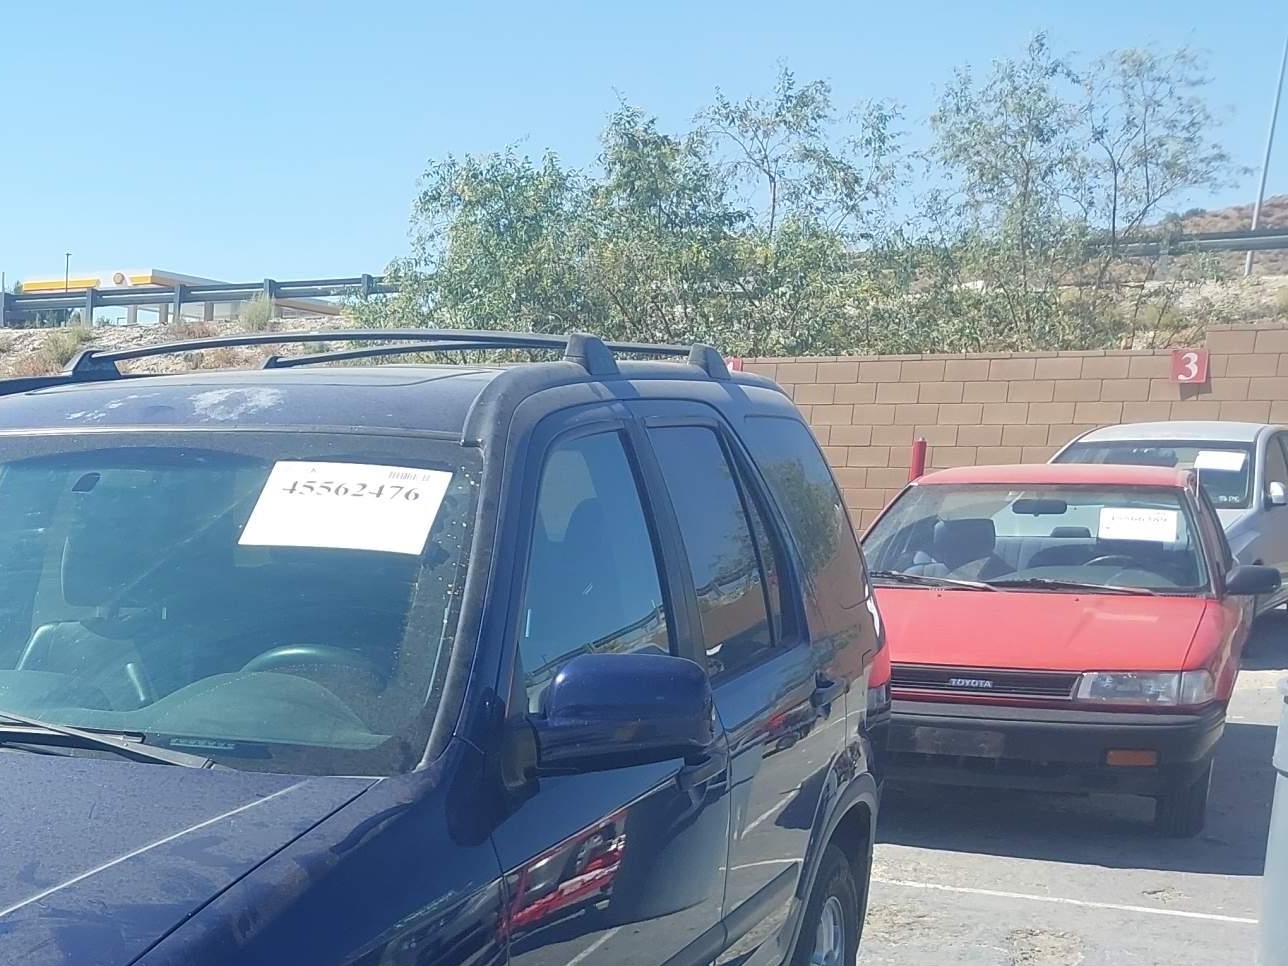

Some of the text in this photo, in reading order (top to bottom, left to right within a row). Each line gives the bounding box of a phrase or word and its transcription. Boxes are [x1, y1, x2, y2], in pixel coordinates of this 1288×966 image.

[1177, 352, 1199, 381] 3
[282, 480, 420, 501] 45562476
[951, 678, 993, 688] TOYOTA
